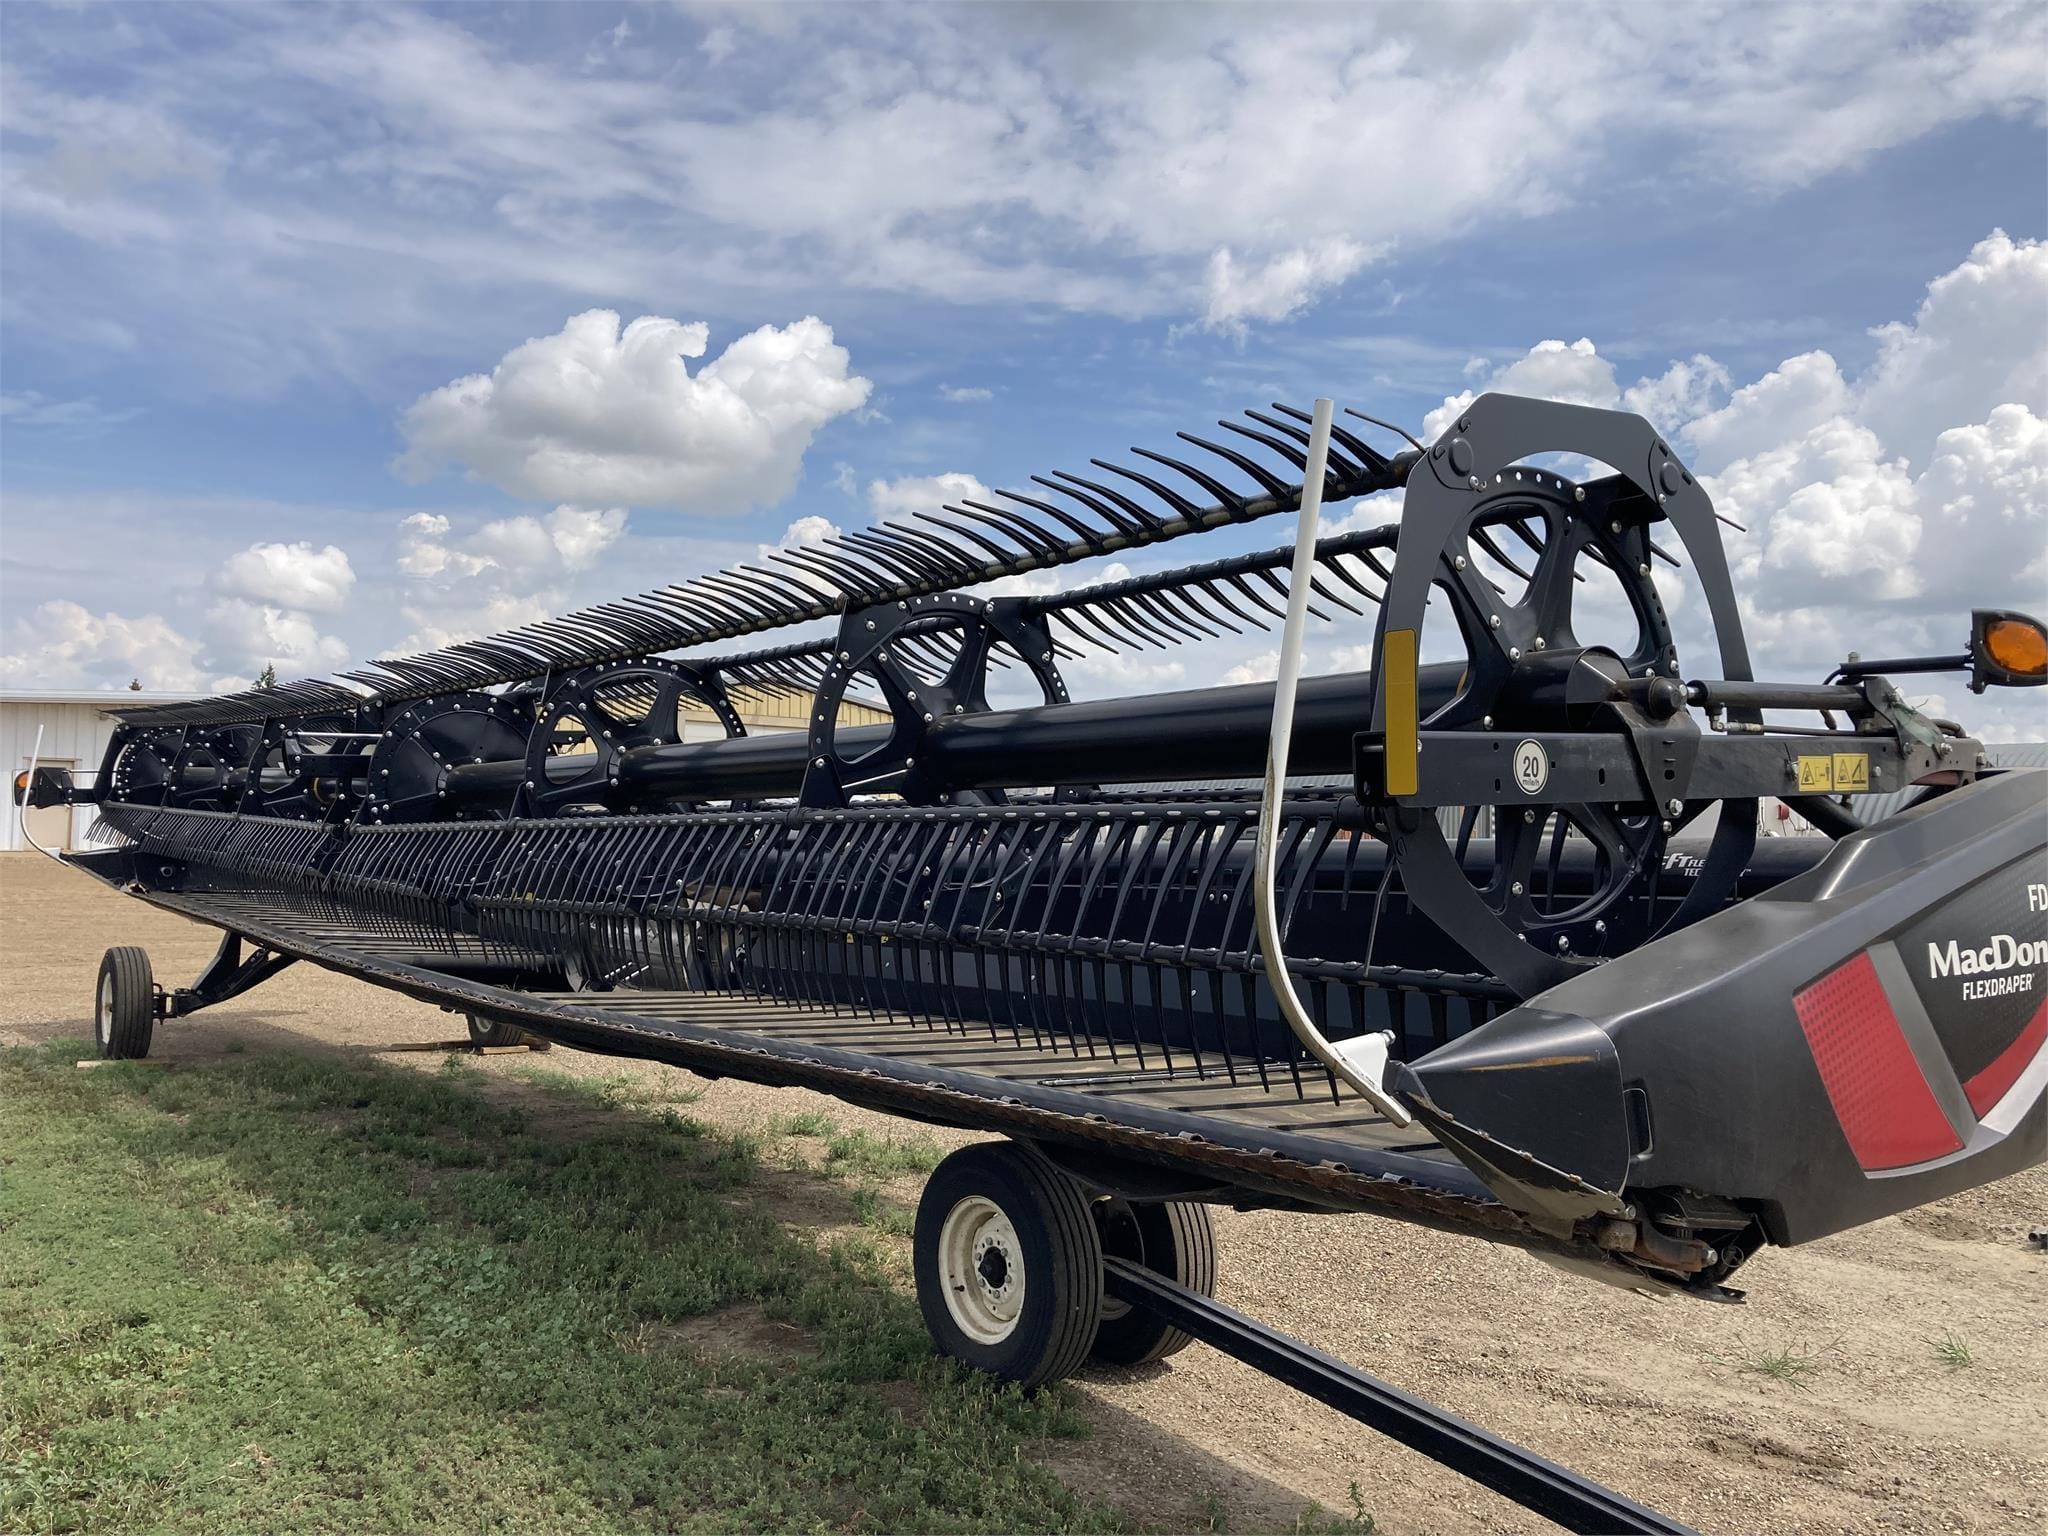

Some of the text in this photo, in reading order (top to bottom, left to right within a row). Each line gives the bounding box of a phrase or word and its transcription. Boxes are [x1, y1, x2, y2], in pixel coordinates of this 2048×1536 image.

[1523, 756, 1539, 778] 20
[1928, 934, 2048, 979] MacDon
[1963, 973, 2033, 1001] FLEXDRAPER
